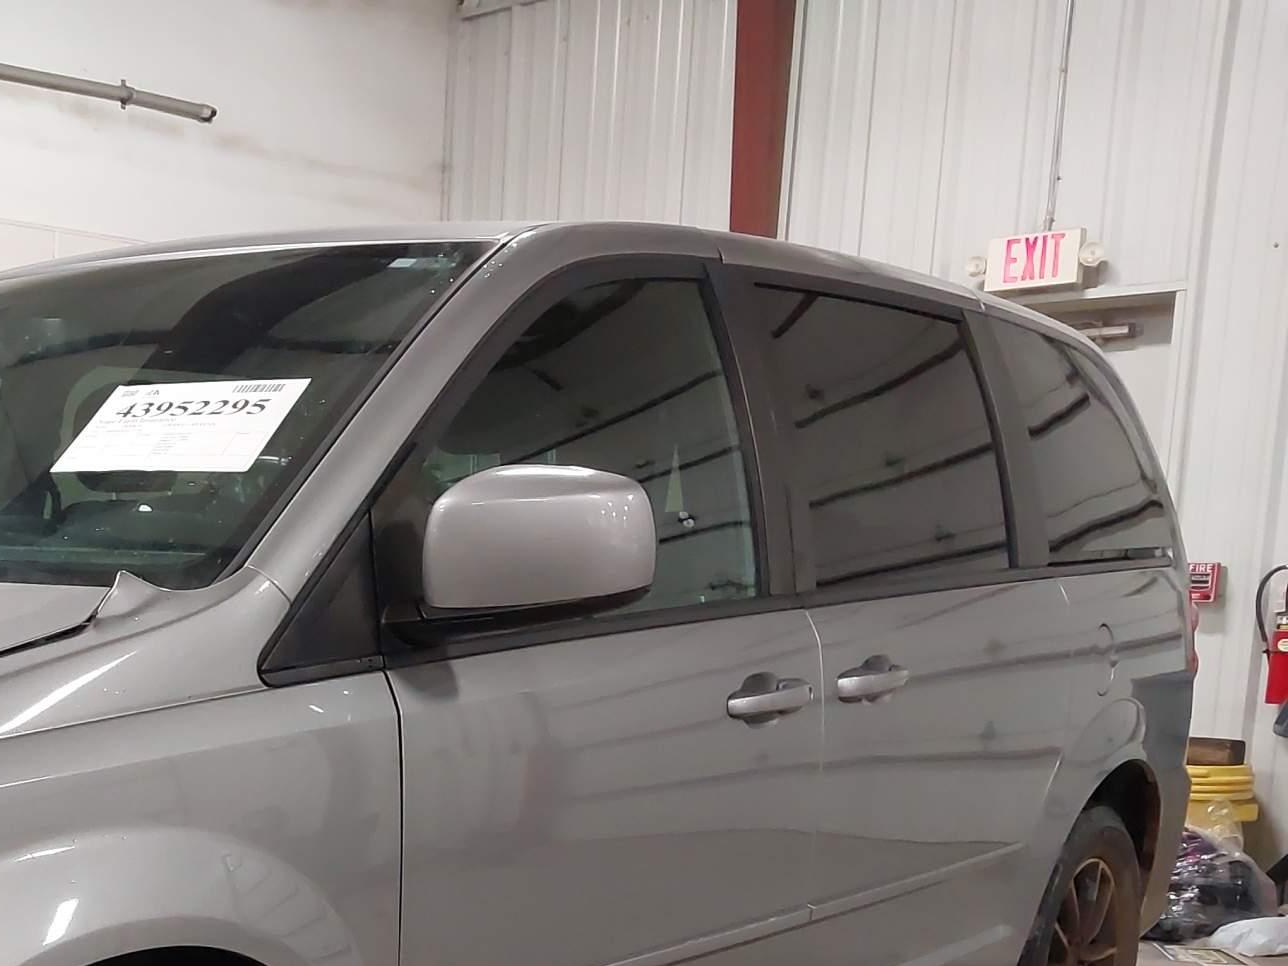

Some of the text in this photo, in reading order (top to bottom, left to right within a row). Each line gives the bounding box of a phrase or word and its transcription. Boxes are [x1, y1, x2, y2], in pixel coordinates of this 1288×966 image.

[1002, 232, 1066, 284] EXIT
[116, 398, 273, 418] 43952295
[1189, 563, 1213, 573] FIRE
